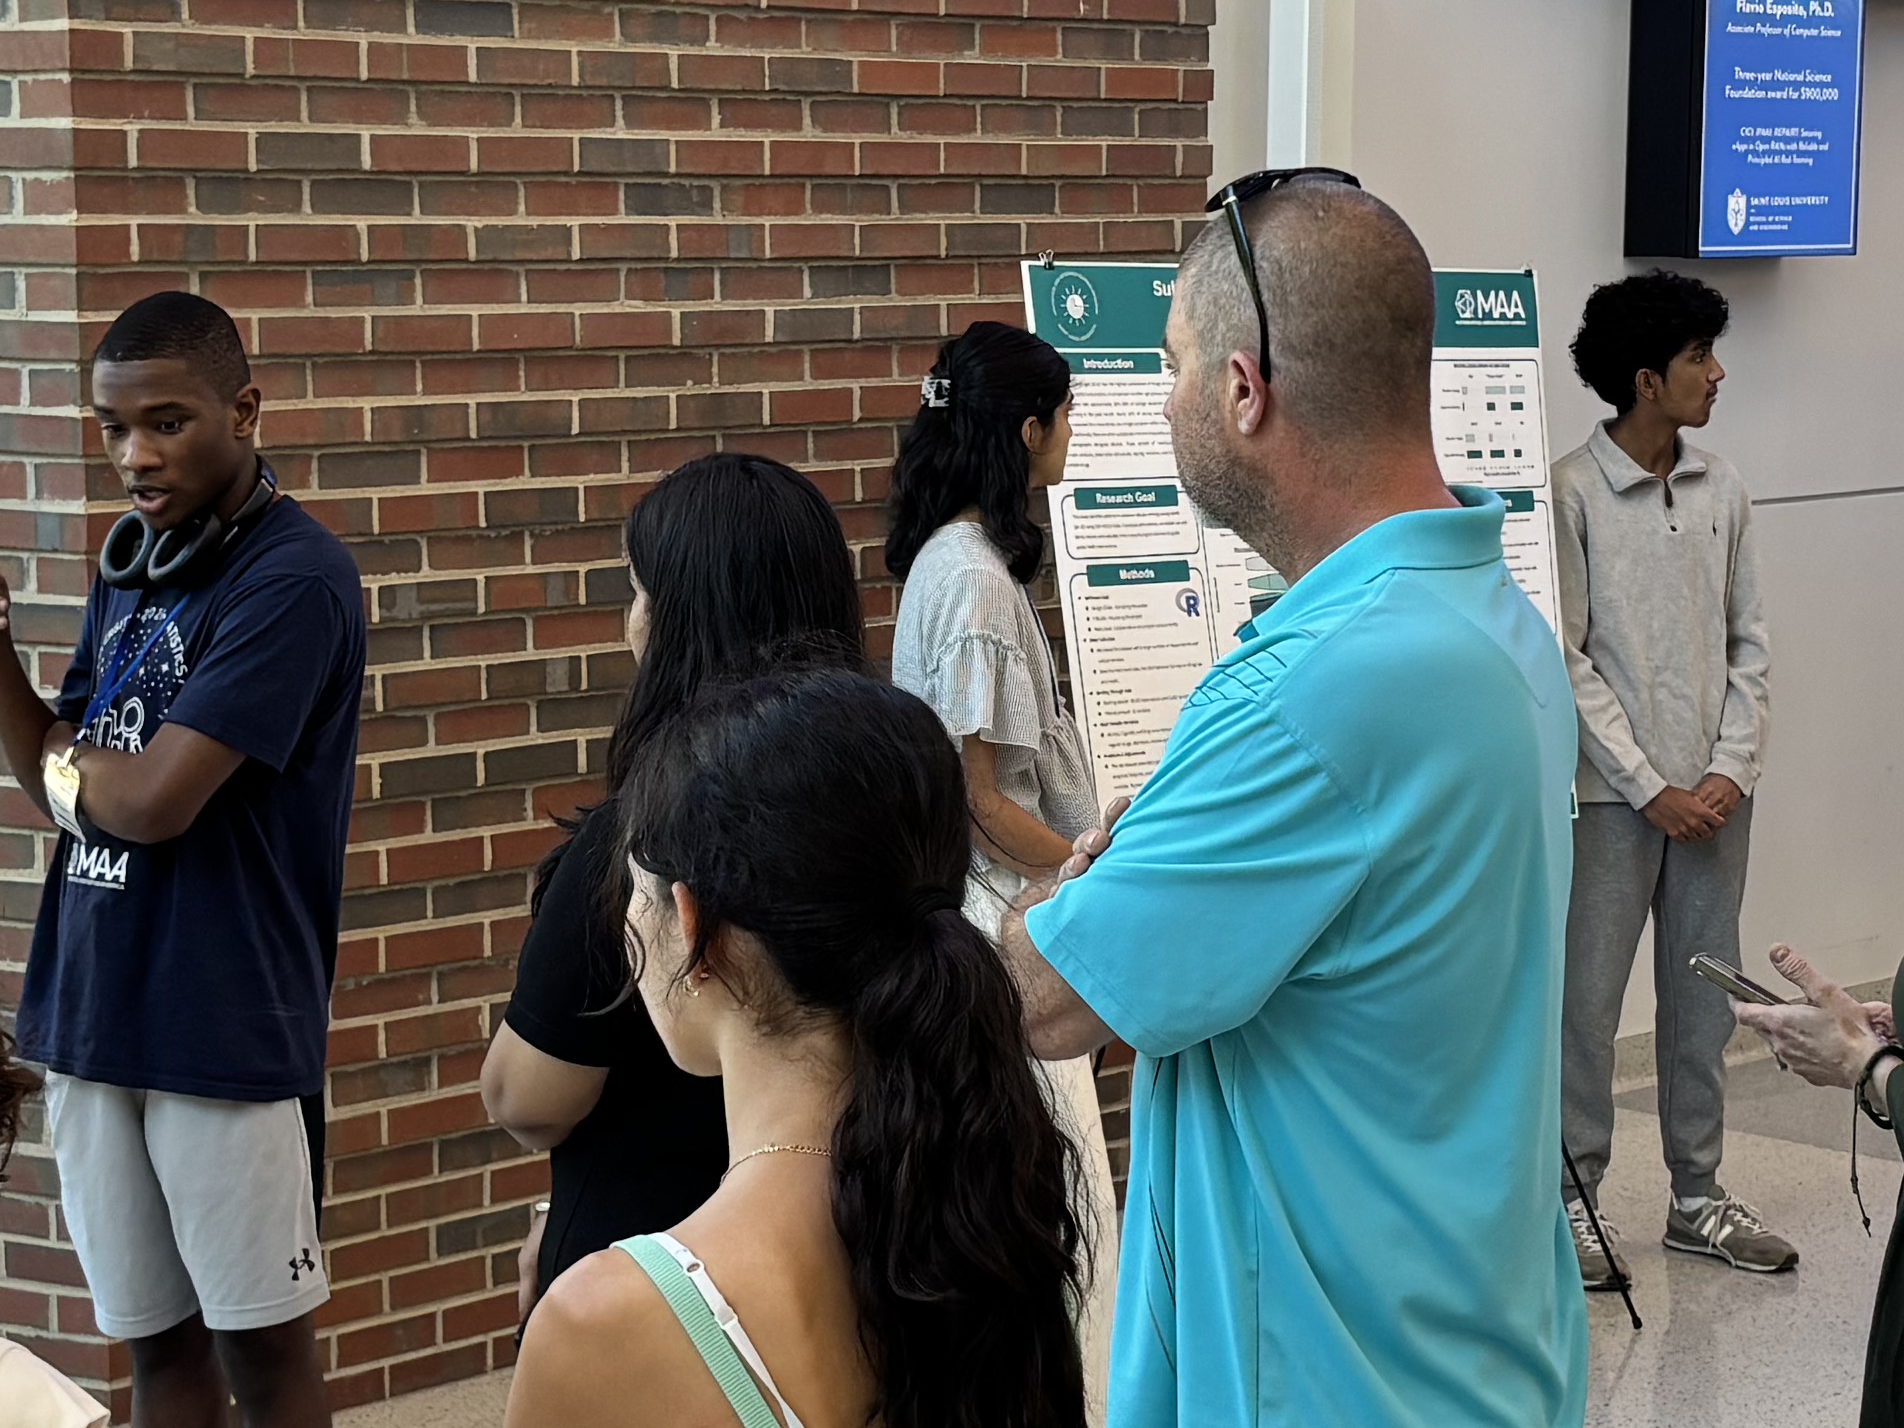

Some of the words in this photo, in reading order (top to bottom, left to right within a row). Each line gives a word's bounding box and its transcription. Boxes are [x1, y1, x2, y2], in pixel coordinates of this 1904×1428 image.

[1766, 0, 1807, 19] Esposito,
[1809, 1, 1834, 17] Ph.D.
[1775, 69, 1804, 82] National
[1805, 70, 1832, 83] Science
[1725, 86, 1766, 99] Foundation
[1477, 289, 1526, 319] MAA
[1083, 358, 1134, 369] Introduction
[1095, 491, 1134, 504] Research
[1135, 490, 1156, 503] Goal
[1185, 595, 1200, 617] R
[76, 843, 130, 883] MAA
